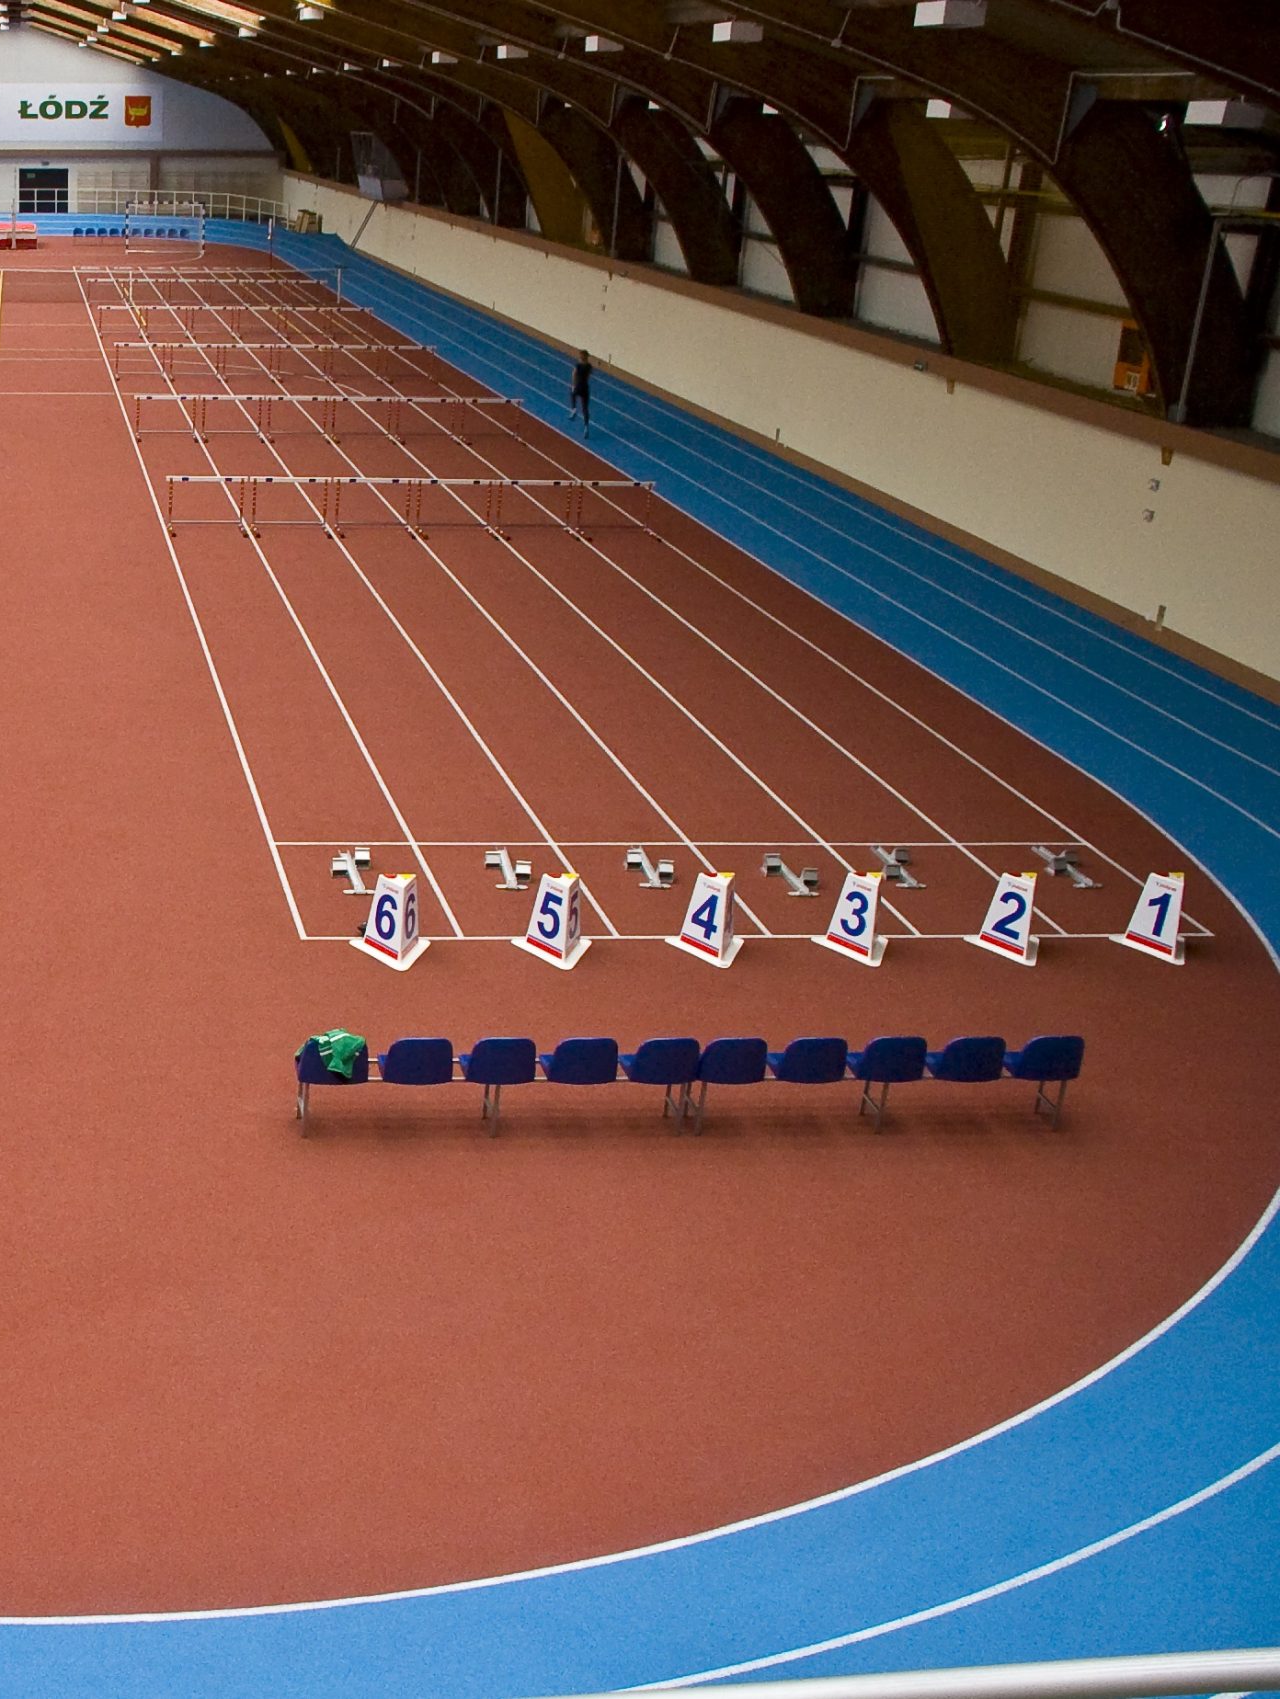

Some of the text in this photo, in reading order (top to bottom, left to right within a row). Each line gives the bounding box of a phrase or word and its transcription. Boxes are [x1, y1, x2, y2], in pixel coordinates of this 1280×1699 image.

[18, 94, 109, 120] ŁÓDŹ
[375, 894, 398, 940] 6
[404, 893, 416, 939] 6
[537, 892, 564, 940] 5
[691, 893, 719, 940] 4
[840, 890, 869, 937] 3
[991, 891, 1027, 940] 2
[1147, 892, 1172, 937] 1
